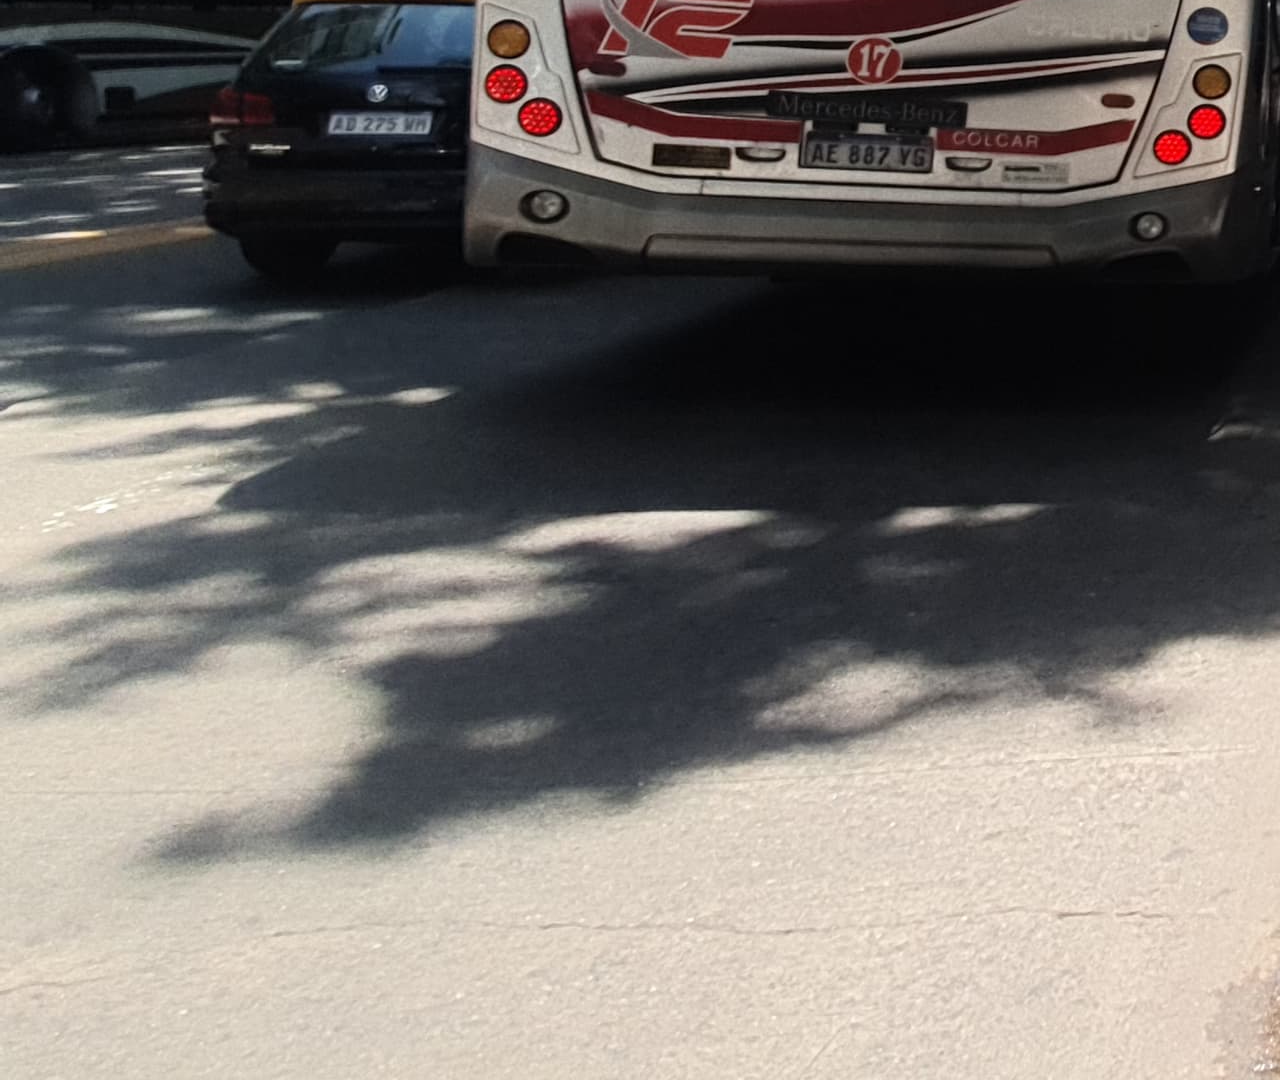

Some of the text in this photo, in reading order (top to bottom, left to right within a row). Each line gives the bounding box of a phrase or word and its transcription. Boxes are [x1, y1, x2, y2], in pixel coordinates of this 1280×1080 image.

[857, 43, 893, 78] 17
[776, 95, 960, 122] Mercedes-Benz
[952, 131, 1040, 149] COLCAR
[811, 143, 837, 164] AE
[849, 145, 889, 166] 887
